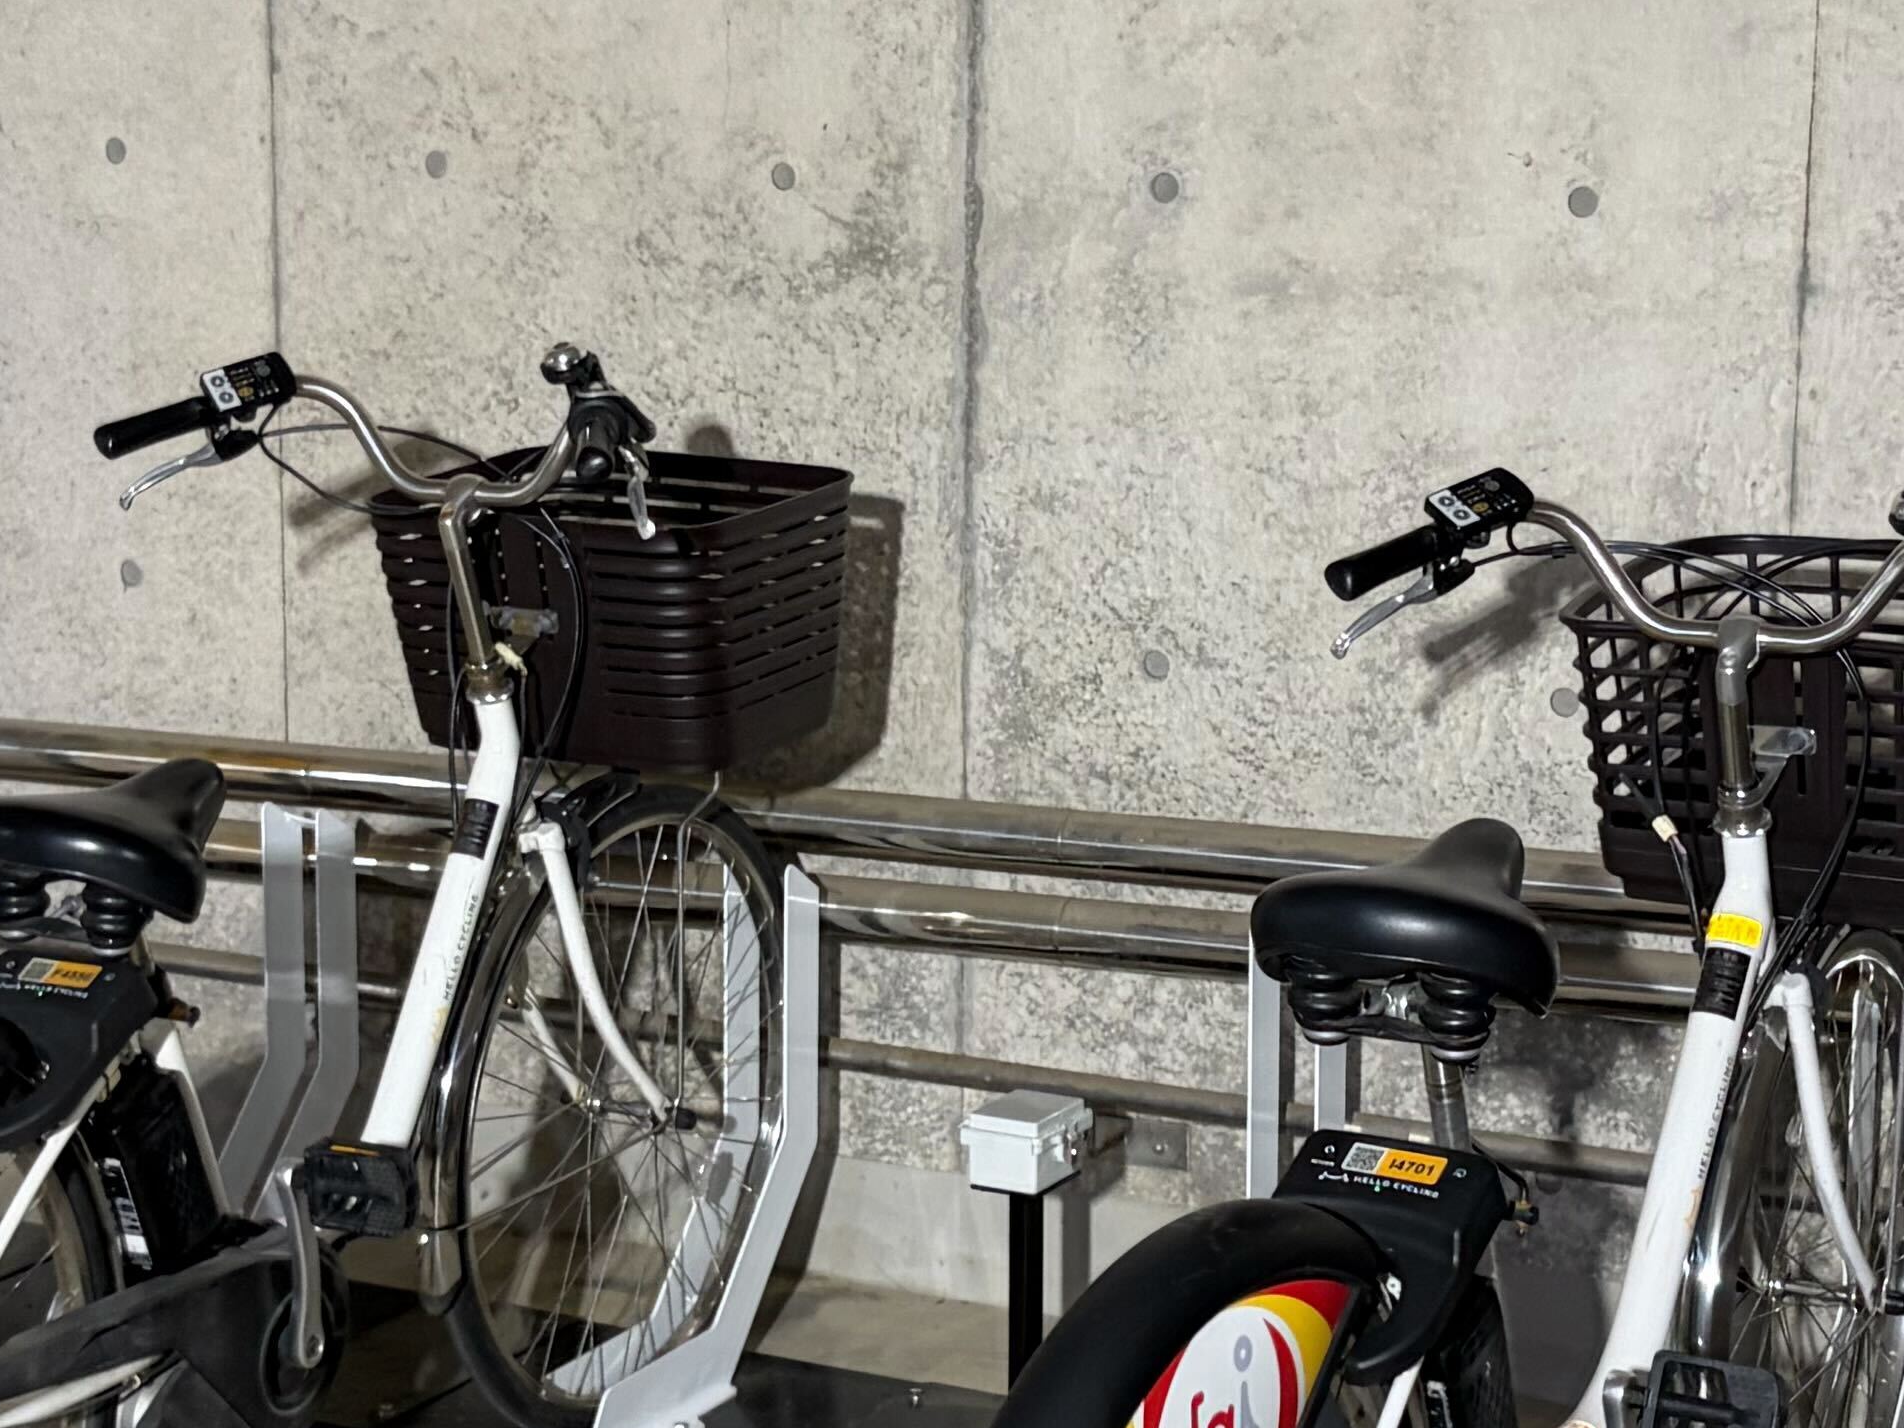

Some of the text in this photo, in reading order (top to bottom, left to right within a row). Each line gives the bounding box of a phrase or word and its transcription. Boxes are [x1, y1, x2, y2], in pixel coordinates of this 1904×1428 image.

[1697, 1056, 1734, 1180] HELLO CYCLING
[1353, 1175, 1440, 1199] HELLO CYCLING
